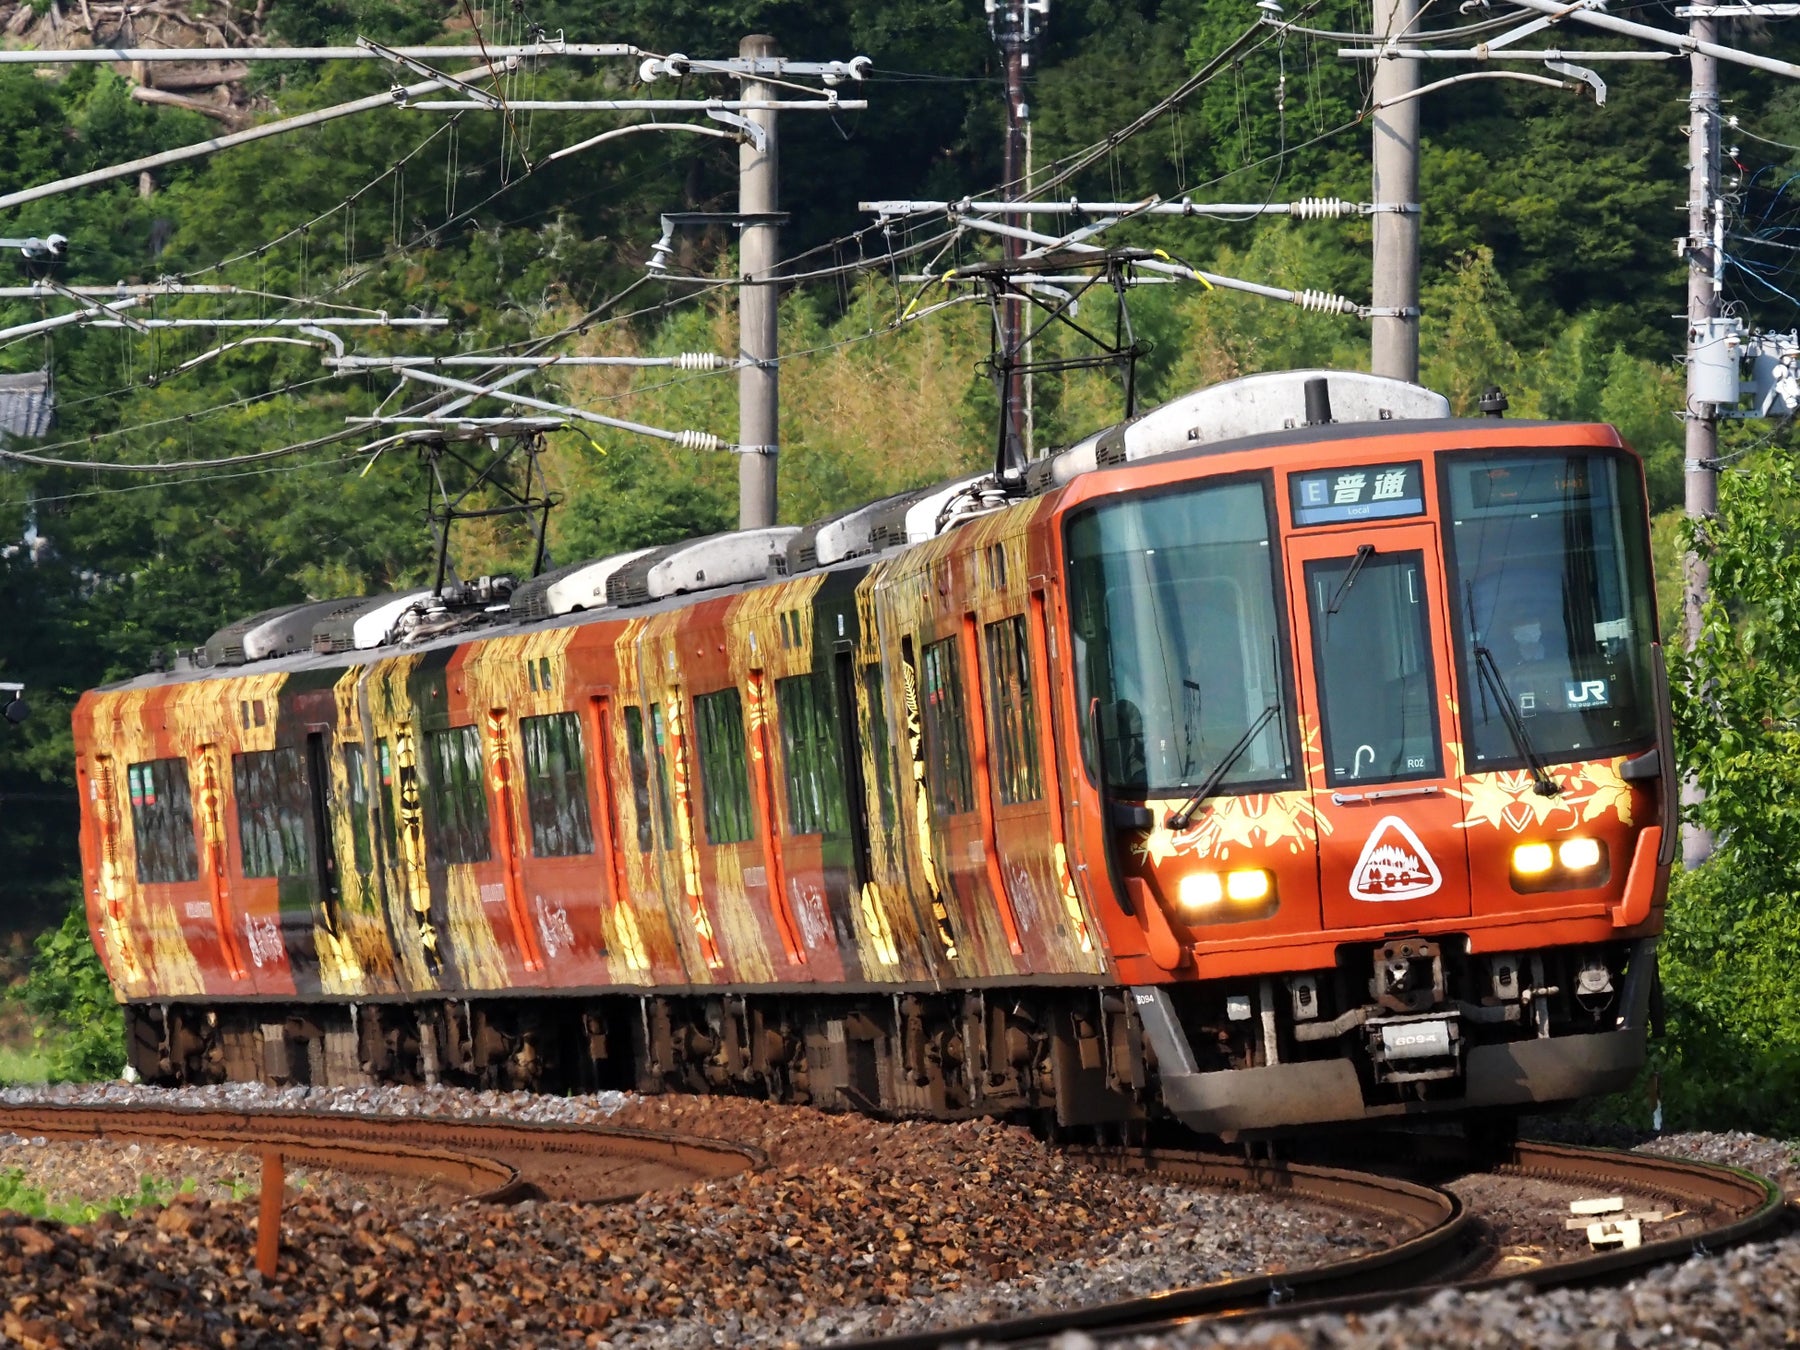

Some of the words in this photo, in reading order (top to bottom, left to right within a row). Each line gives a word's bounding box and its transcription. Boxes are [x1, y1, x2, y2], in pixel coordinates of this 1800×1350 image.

[1308, 483, 1321, 502] E
[1333, 468, 1407, 504] 普通
[1347, 505, 1370, 516] Local
[1568, 680, 1606, 702] JR
[1407, 758, 1425, 769] R02
